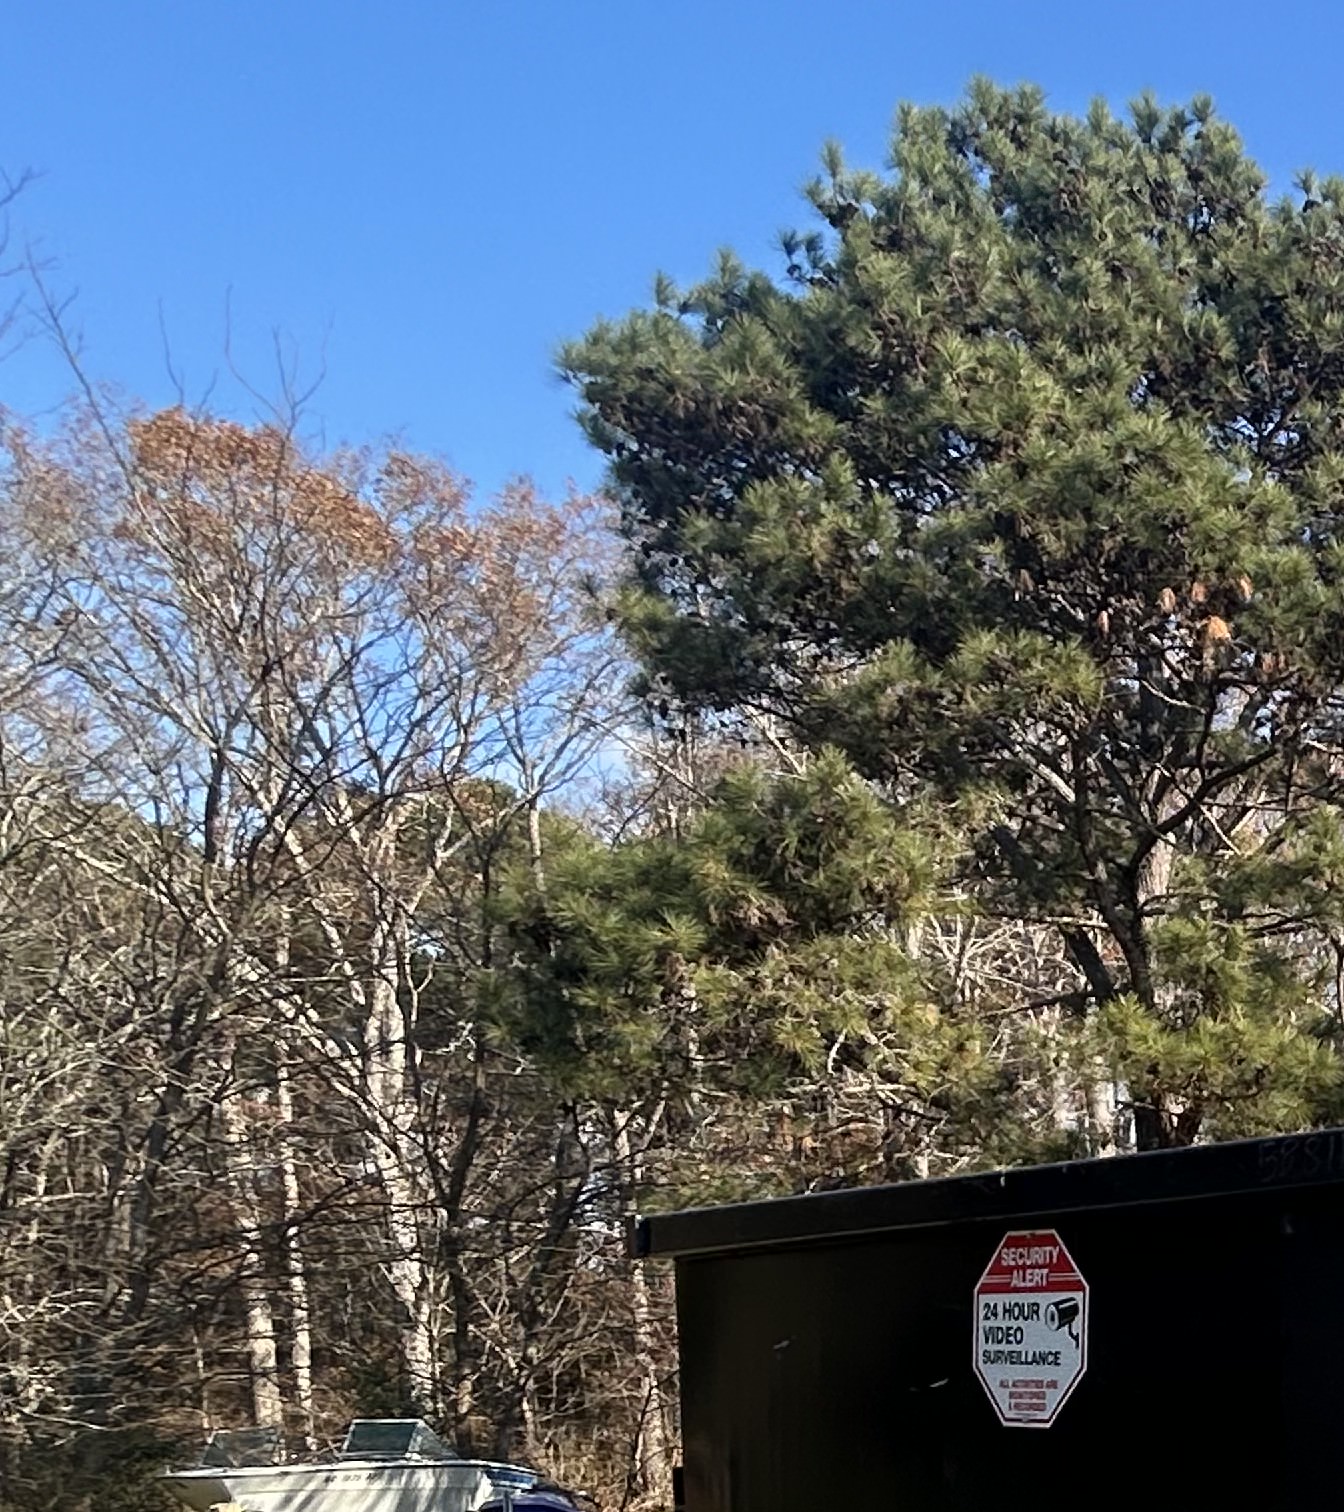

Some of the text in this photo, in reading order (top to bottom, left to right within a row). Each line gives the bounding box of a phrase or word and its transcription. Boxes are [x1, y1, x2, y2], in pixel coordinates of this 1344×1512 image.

[1002, 1246, 1060, 1266] SECURITY
[1010, 1268, 1049, 1288] ALERT
[983, 1300, 1040, 1321] 24 HOUR
[983, 1326, 1024, 1345] VIDEO
[982, 1350, 1061, 1366] SURVEILLANCE
